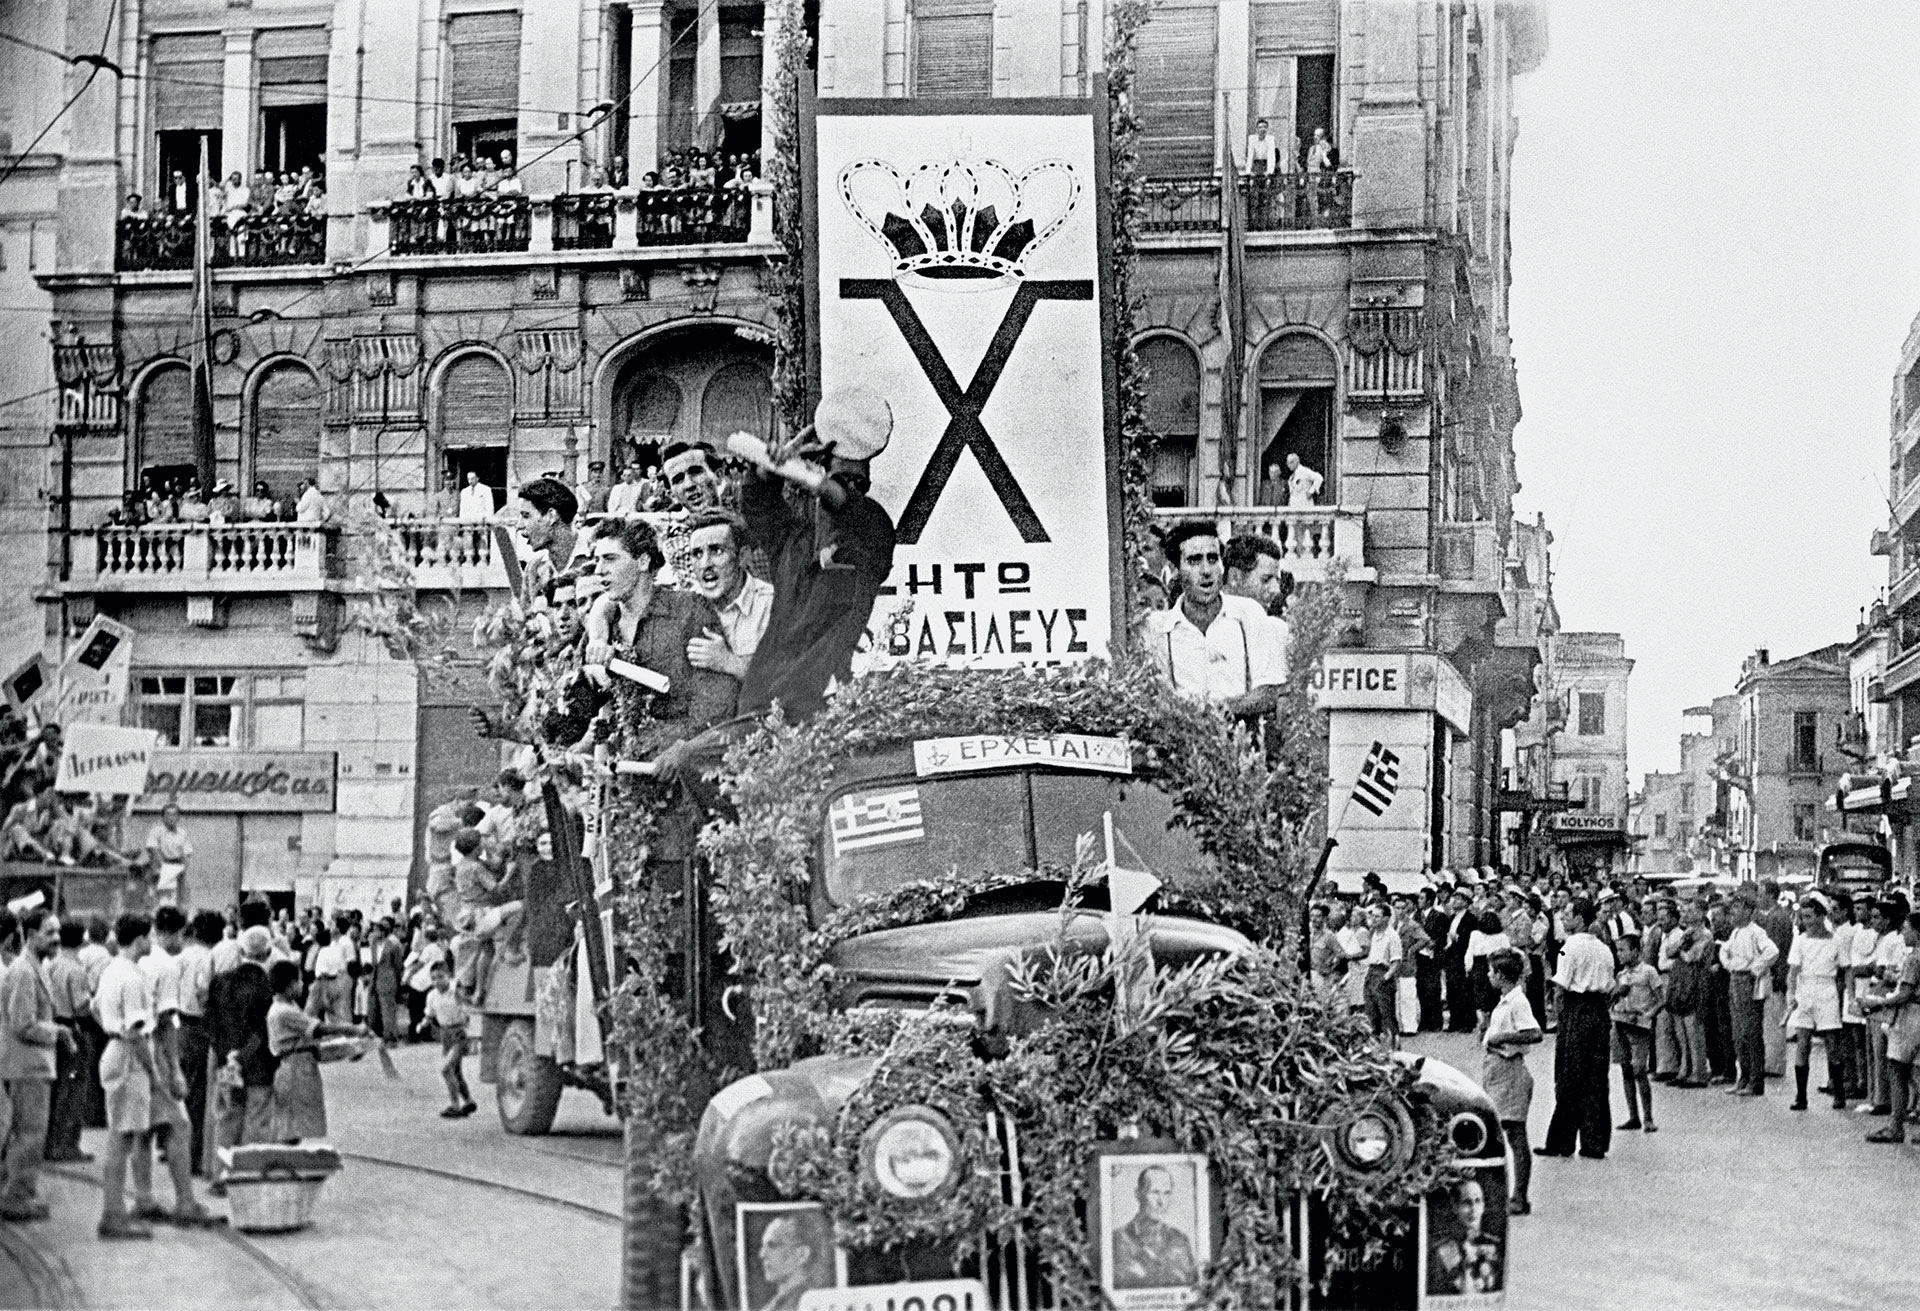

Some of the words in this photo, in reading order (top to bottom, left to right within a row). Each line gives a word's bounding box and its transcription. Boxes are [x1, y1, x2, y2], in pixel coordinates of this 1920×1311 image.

[880, 562, 1031, 599] ΗΤΩ
[889, 608, 1088, 656] ΒΑΣΙΛΕΥΣ
[1312, 668, 1397, 691] OFFICE
[1561, 817, 1614, 828] KOLYNOS
